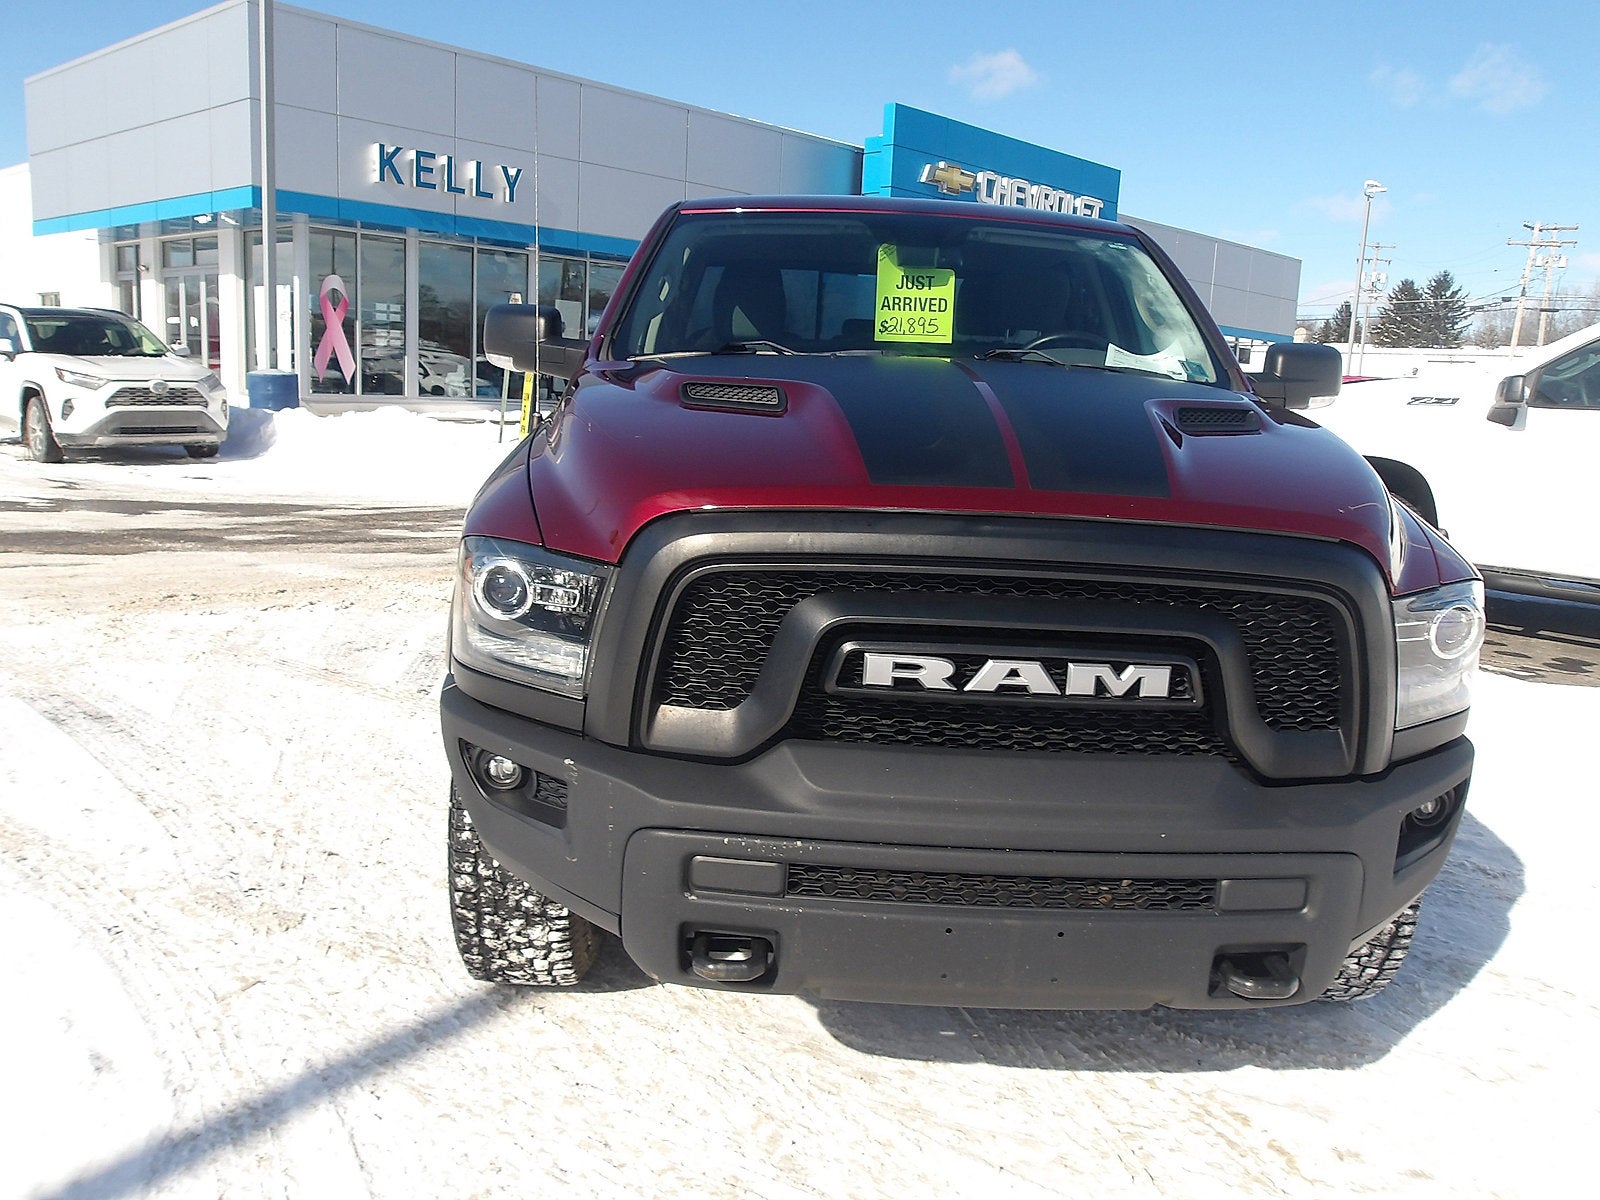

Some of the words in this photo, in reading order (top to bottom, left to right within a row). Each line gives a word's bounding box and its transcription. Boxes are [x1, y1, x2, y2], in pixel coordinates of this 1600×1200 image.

[376, 143, 523, 203] KELLY
[977, 171, 1103, 219] CHEVROLET
[881, 296, 948, 313] ARRIVED
[896, 275, 935, 290] JUST
[862, 652, 1172, 698] RAM
